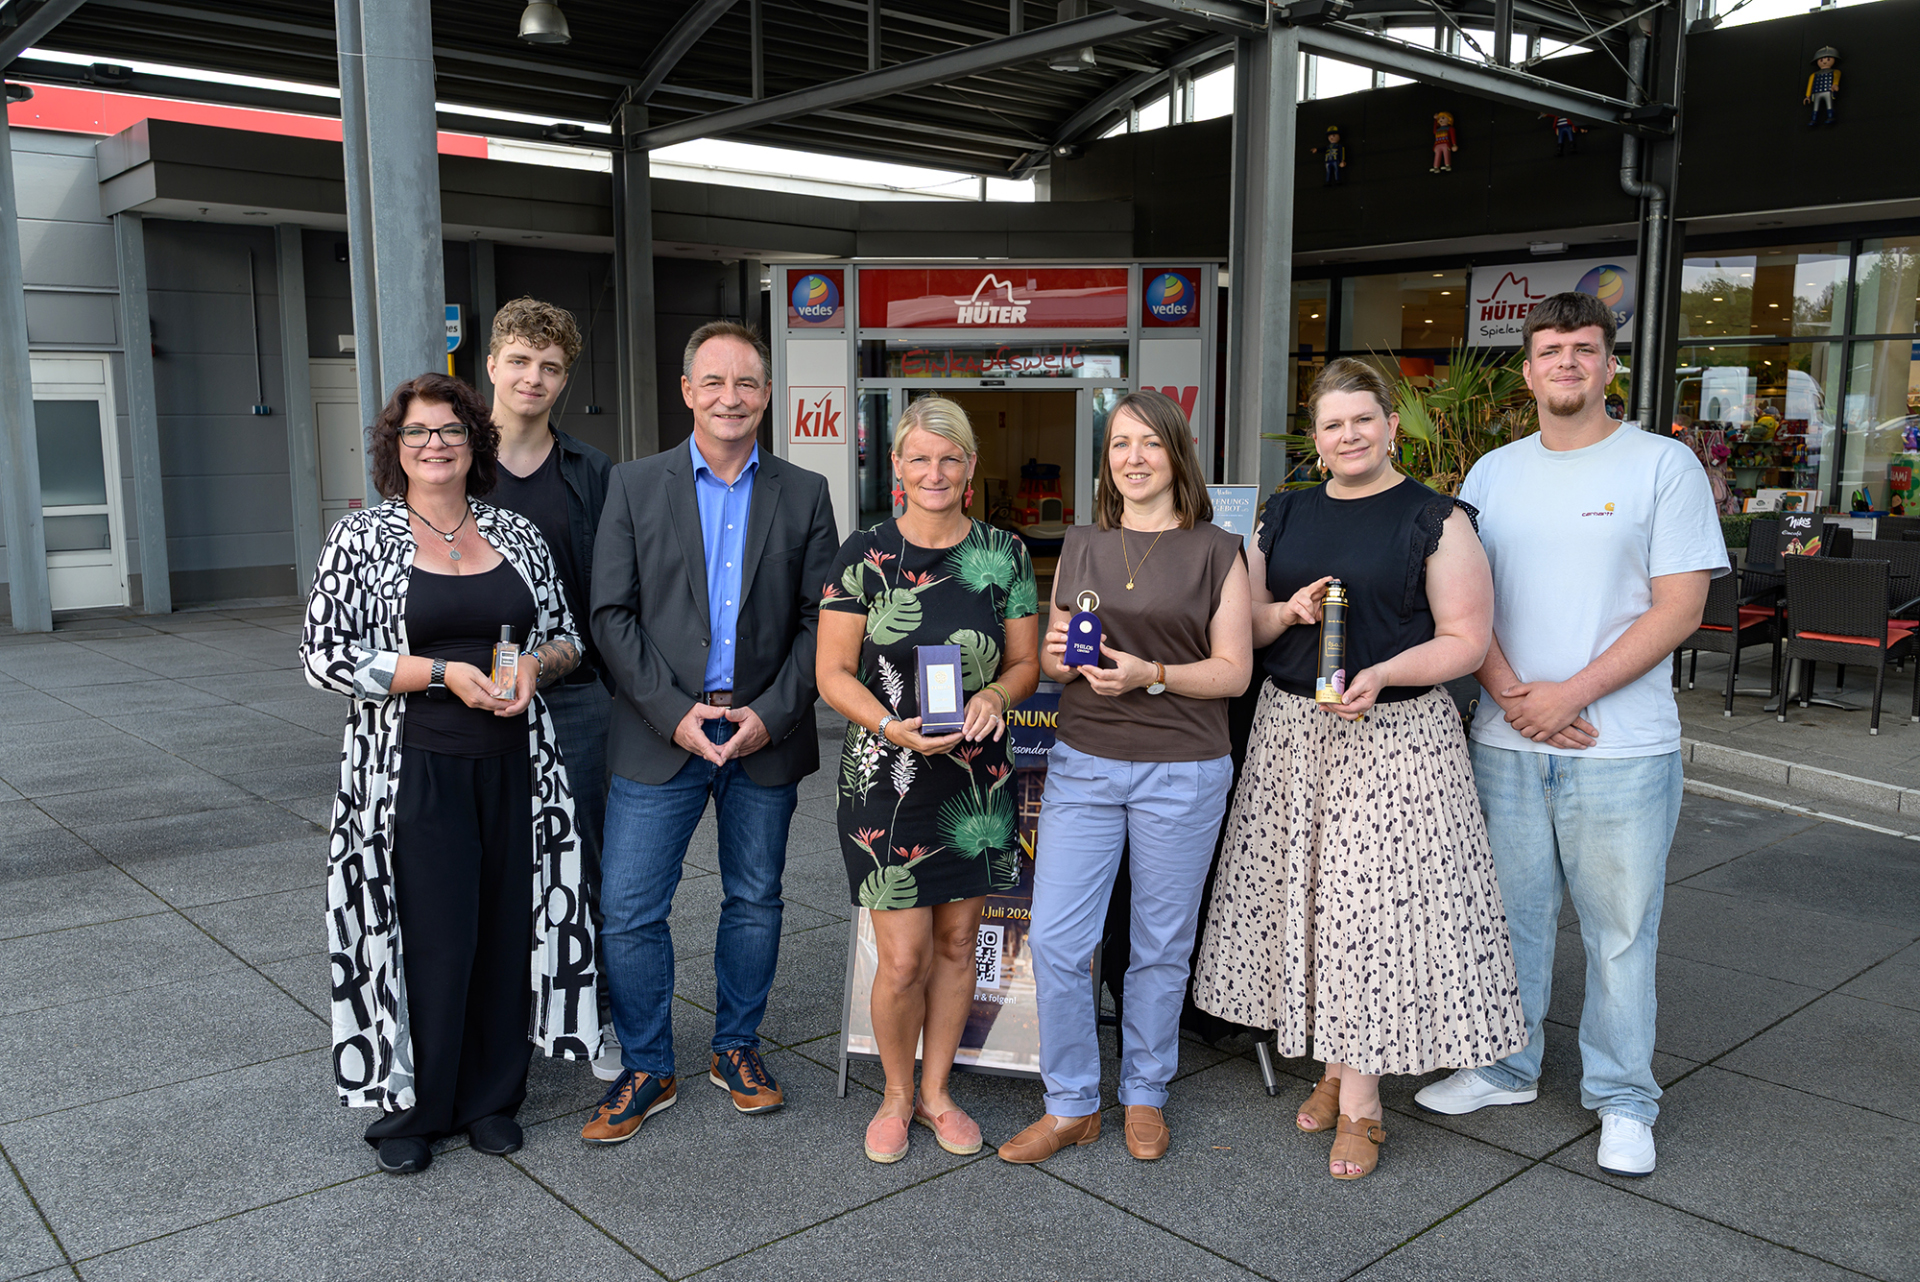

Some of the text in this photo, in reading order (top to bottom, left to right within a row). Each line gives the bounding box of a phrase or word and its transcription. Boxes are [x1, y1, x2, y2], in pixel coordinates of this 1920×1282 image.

[798, 303, 833, 316] vedes
[957, 301, 1027, 324] HÜTER
[1152, 302, 1188, 315] vedes
[794, 390, 842, 437] kik
